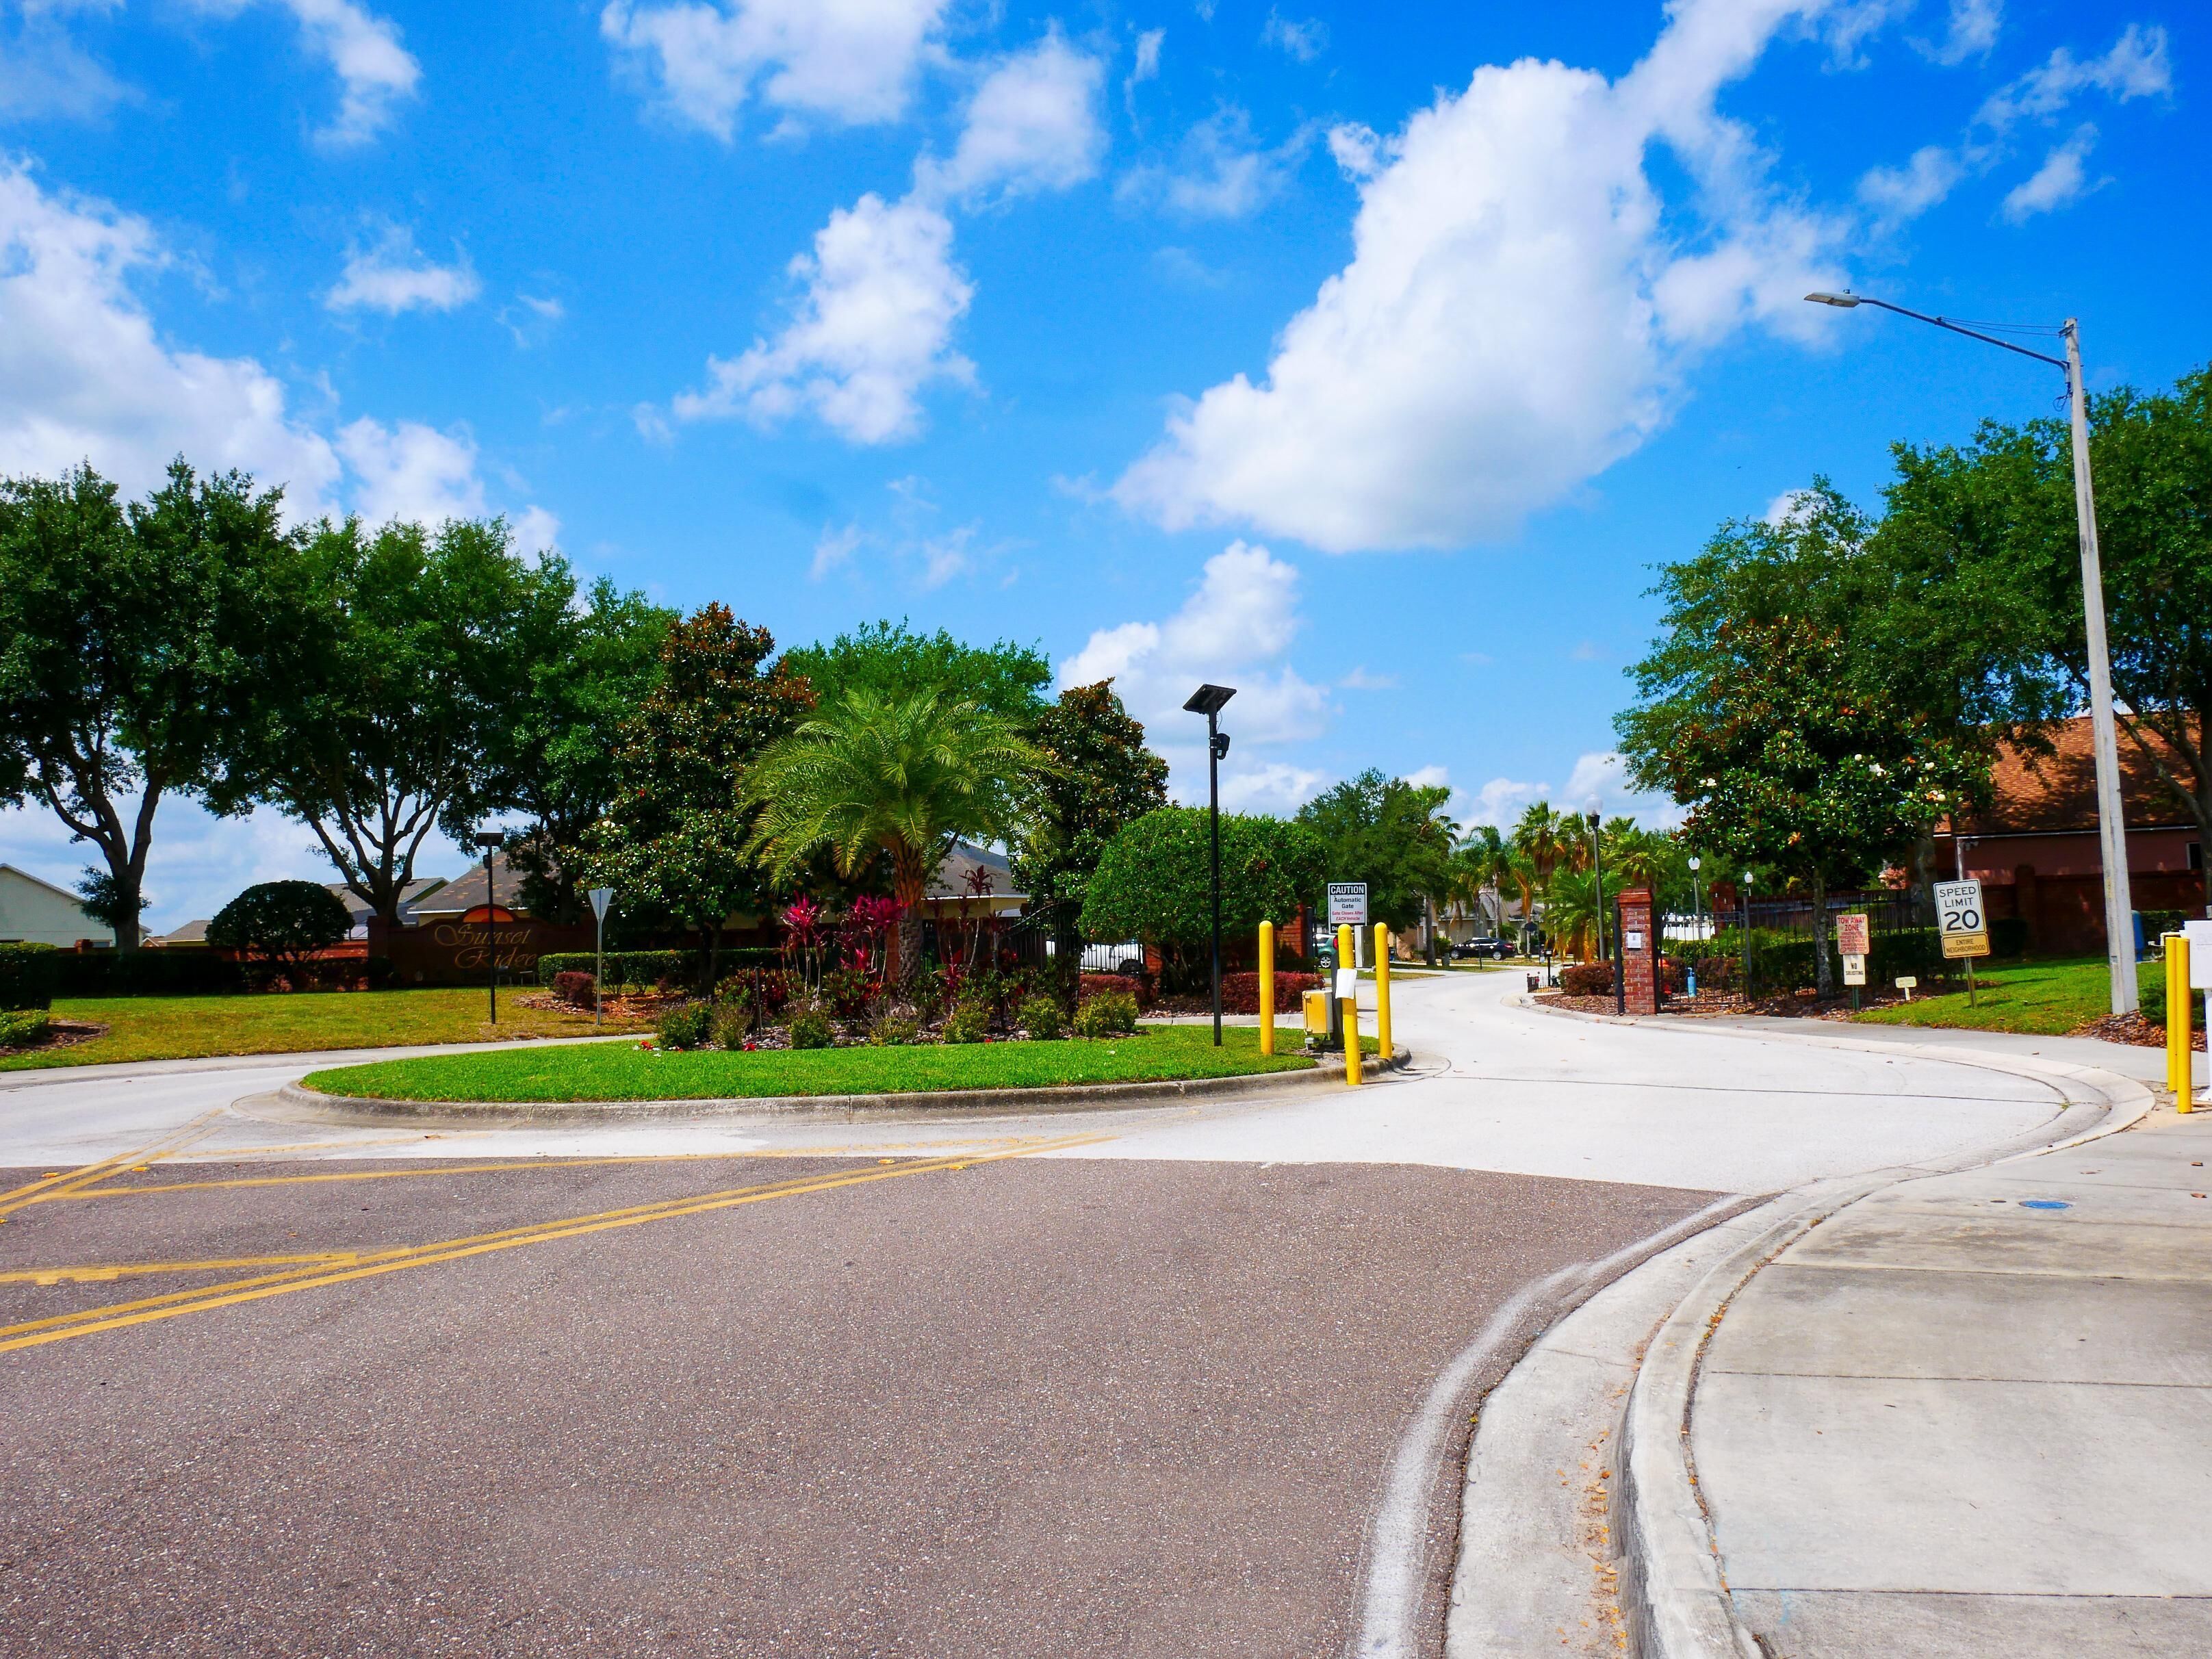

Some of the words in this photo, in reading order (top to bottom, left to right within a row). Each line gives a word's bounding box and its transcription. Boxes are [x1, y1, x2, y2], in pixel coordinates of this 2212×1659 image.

[1330, 886, 1364, 894] CAUTION
[1939, 886, 1977, 897] SPEED
[1944, 897, 1973, 908] LIMIT
[1944, 910, 1979, 931] 20
[435, 924, 531, 947] Sunset
[1946, 945, 1985, 953] NEIGHBORHOOD
[454, 947, 537, 969] Ridge
